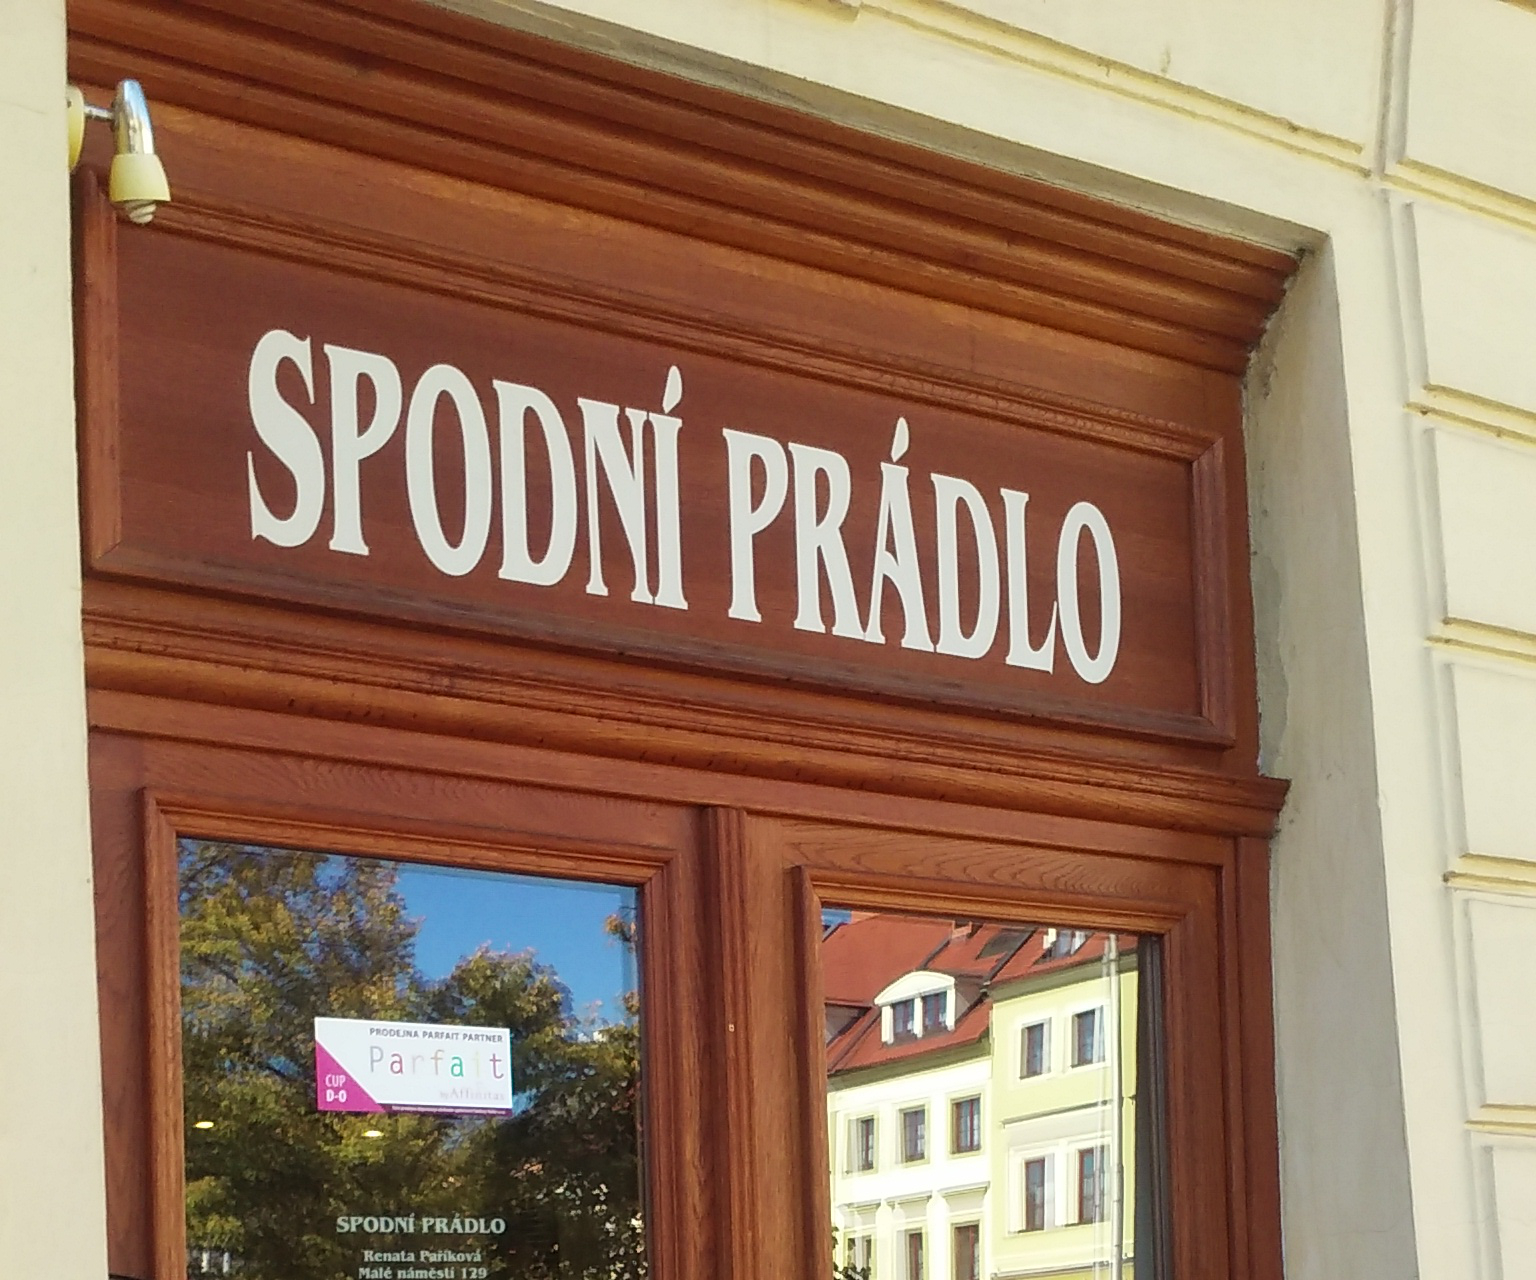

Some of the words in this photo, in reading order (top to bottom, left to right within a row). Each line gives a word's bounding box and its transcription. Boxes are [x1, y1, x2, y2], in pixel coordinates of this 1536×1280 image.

[248, 329, 688, 610] SPODNÍ
[722, 416, 1122, 685] PRÁDLO
[369, 1027, 419, 1038] PRODEJNA
[422, 1031, 460, 1041] PARFAIT
[463, 1033, 503, 1043] PARTNER
[370, 1045, 504, 1079] Parfait
[325, 1074, 346, 1088] CUP
[336, 1213, 415, 1233] SPODNÍ
[422, 1213, 506, 1234] PRÁDLO
[363, 1250, 415, 1262] Renata
[420, 1250, 481, 1263] Paříková
[358, 1267, 392, 1279] Malé
[397, 1267, 455, 1279] náměstí
[461, 1268, 487, 1279] 129
